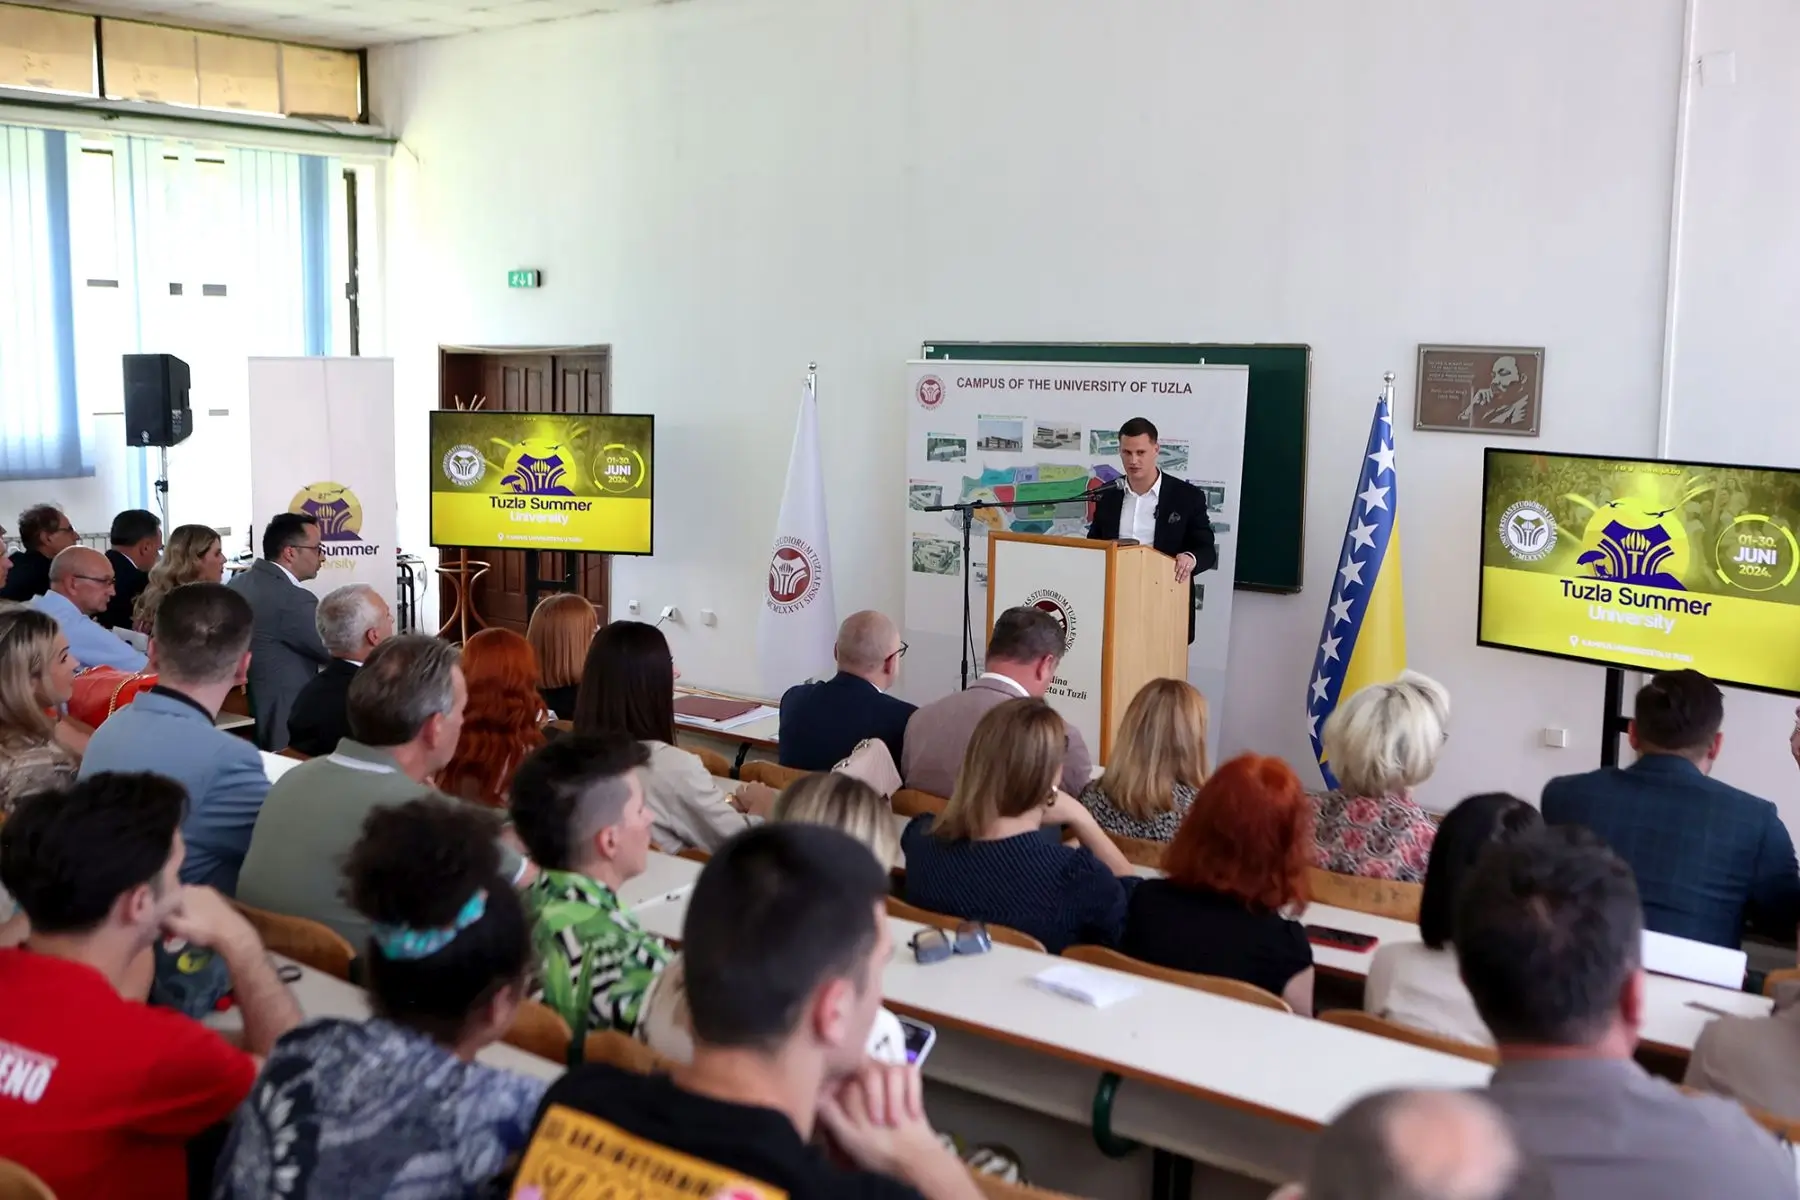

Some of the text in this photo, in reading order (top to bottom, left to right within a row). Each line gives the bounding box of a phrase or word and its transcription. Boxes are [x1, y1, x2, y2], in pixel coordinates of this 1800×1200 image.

[956, 377, 1193, 394] CAMPUS OF THE UNIVERSITY OF TUZLA
[604, 464, 631, 475] JUNI
[489, 496, 592, 511] Tuzla Summer
[510, 511, 568, 526] University
[1738, 534, 1777, 547] 01-30.
[318, 543, 379, 556] Summer
[1733, 546, 1777, 565] JUNI
[1739, 564, 1772, 578] 2024.
[1560, 579, 1712, 616] Tuzla Summer
[1588, 605, 1676, 634] University
[1067, 688, 1087, 700] Tuzli
